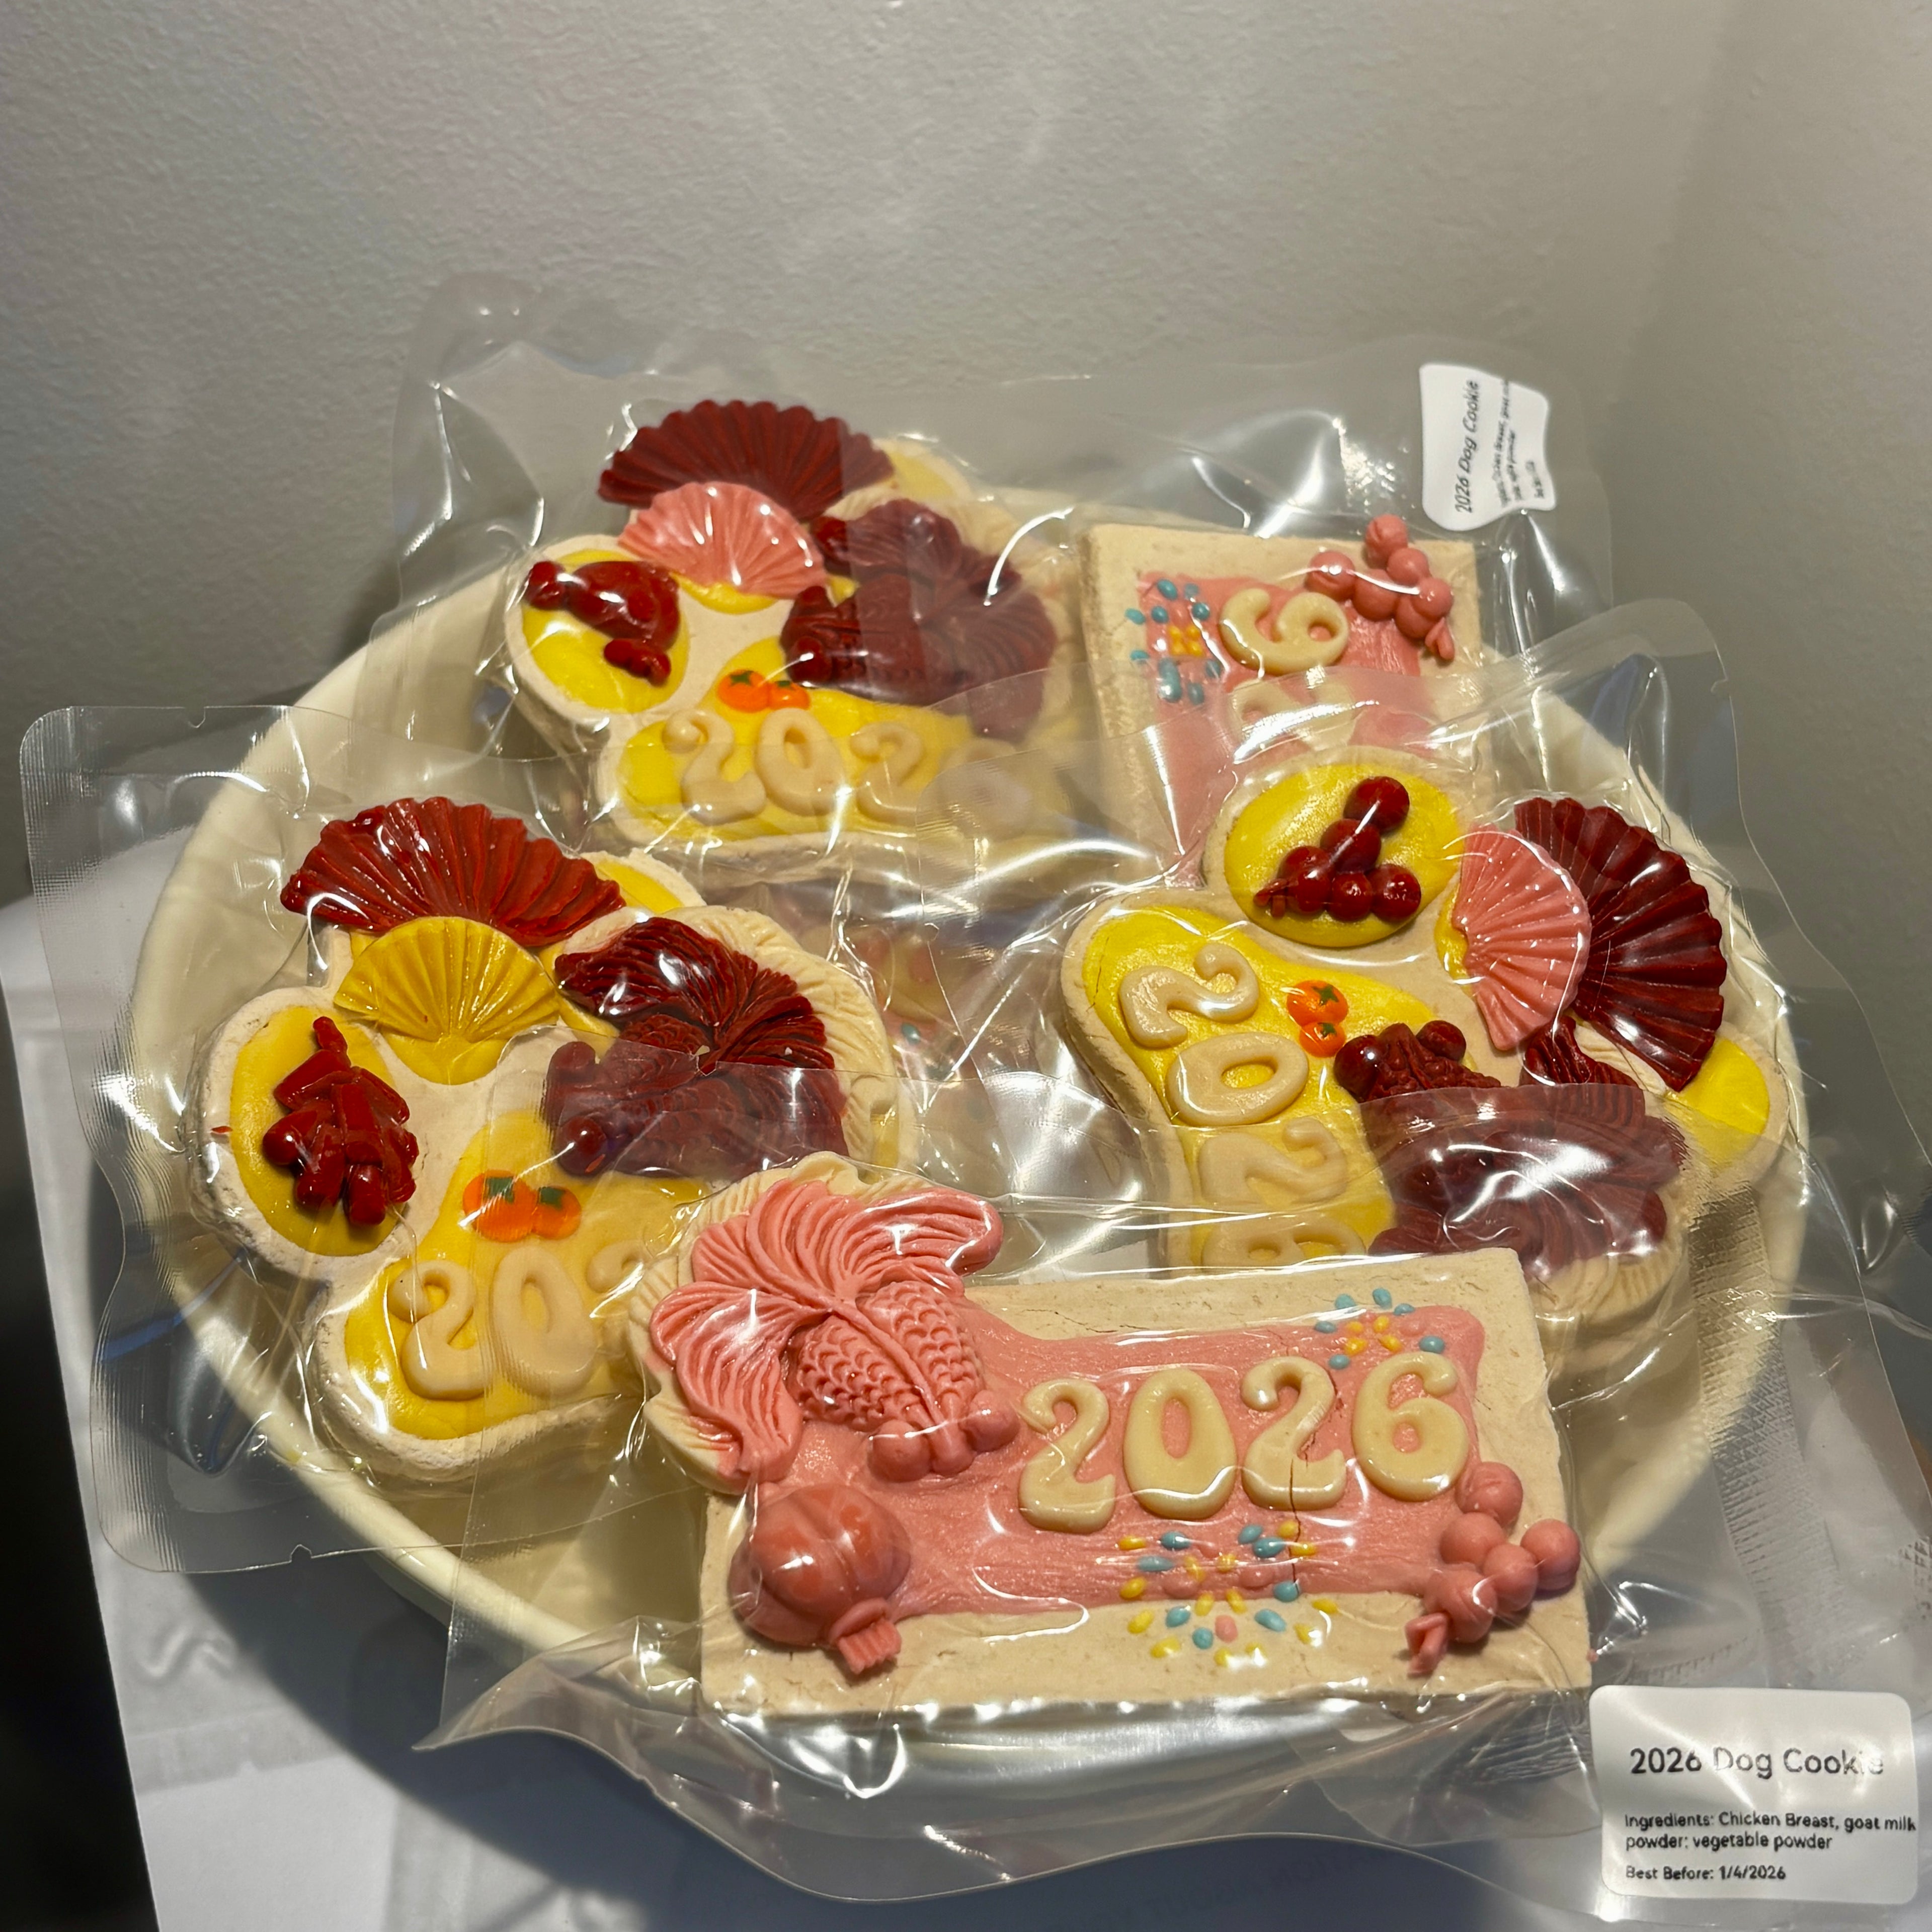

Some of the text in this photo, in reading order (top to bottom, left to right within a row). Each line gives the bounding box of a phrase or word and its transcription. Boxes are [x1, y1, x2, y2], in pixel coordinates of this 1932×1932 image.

[1454, 379, 1480, 514] 2026 Dog Cookie
[1017, 1350, 1470, 1535] 2026
[1630, 1747, 1884, 1780] 2026 Dog Cookie
[1625, 1811, 1916, 1833] Ingredients: Chicken Breast, goat milk
[1693, 1830, 1769, 1852] vegetable
[1774, 1833, 1833, 1853] powder
[1626, 1865, 1787, 1880] Best Before: 1/4/2026
